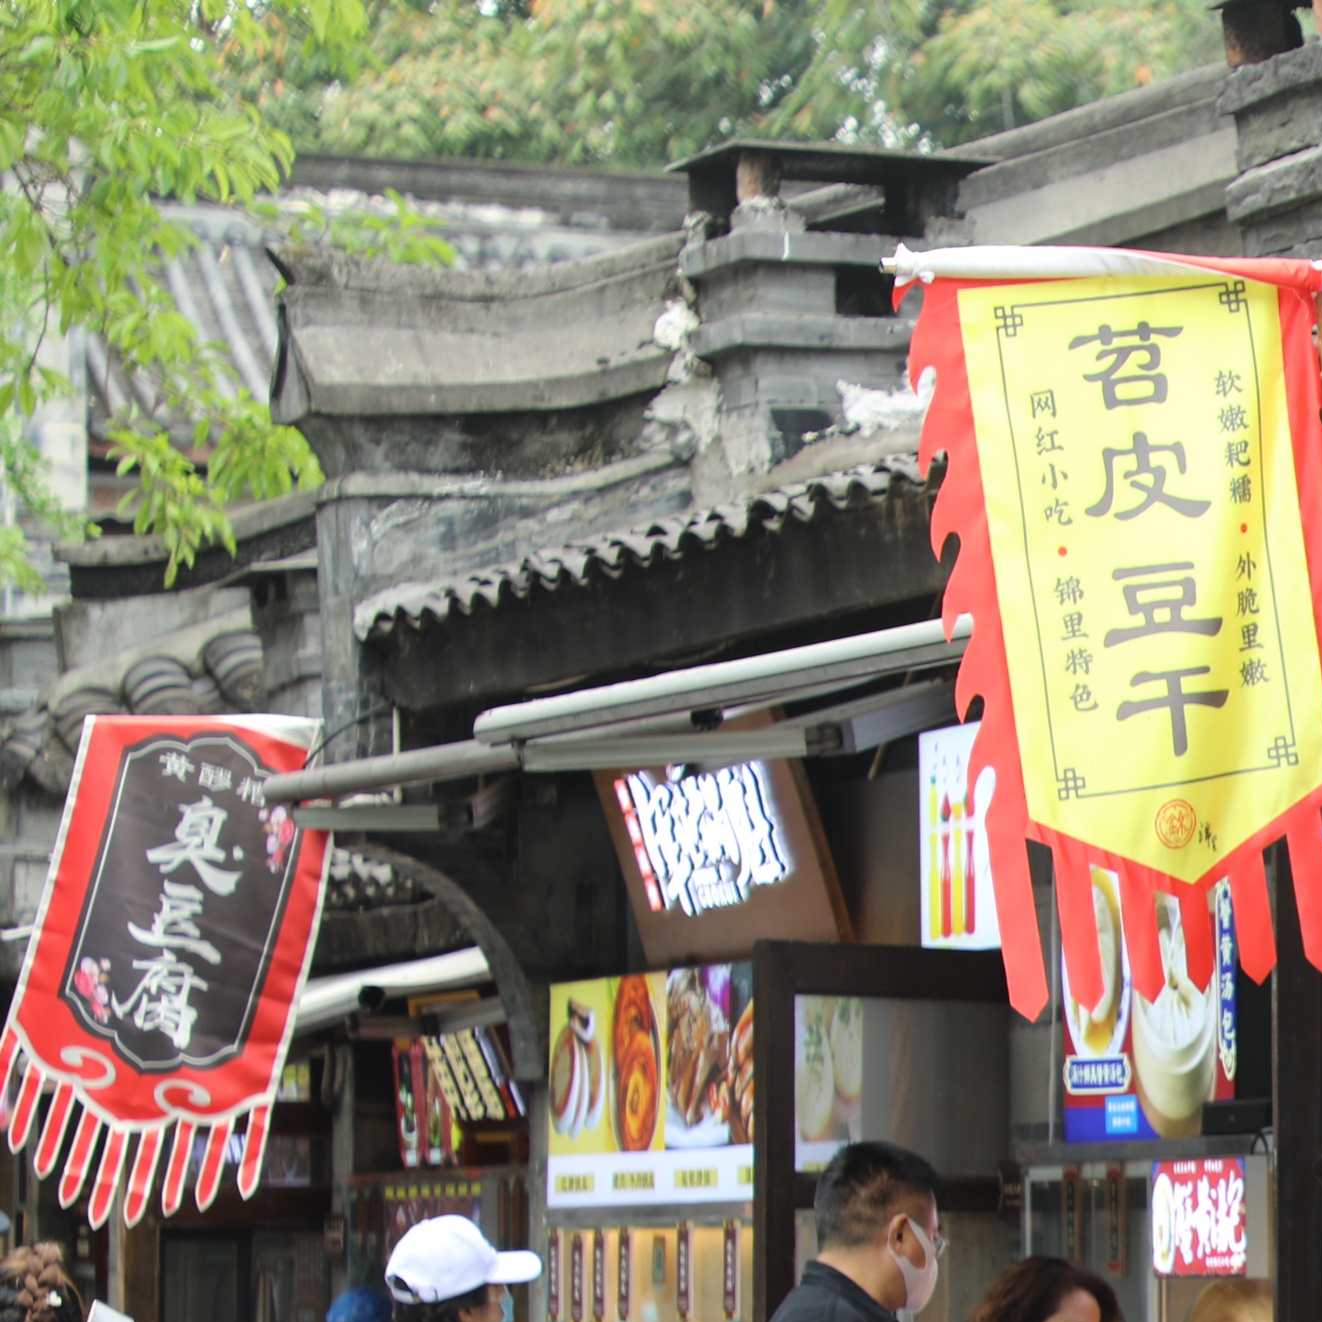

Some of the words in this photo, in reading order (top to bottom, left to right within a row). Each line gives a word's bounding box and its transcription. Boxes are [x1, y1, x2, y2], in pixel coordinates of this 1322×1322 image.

[1069, 320, 1230, 757] 苕皮豆干
[111, 796, 244, 1050] 臭豆腐
